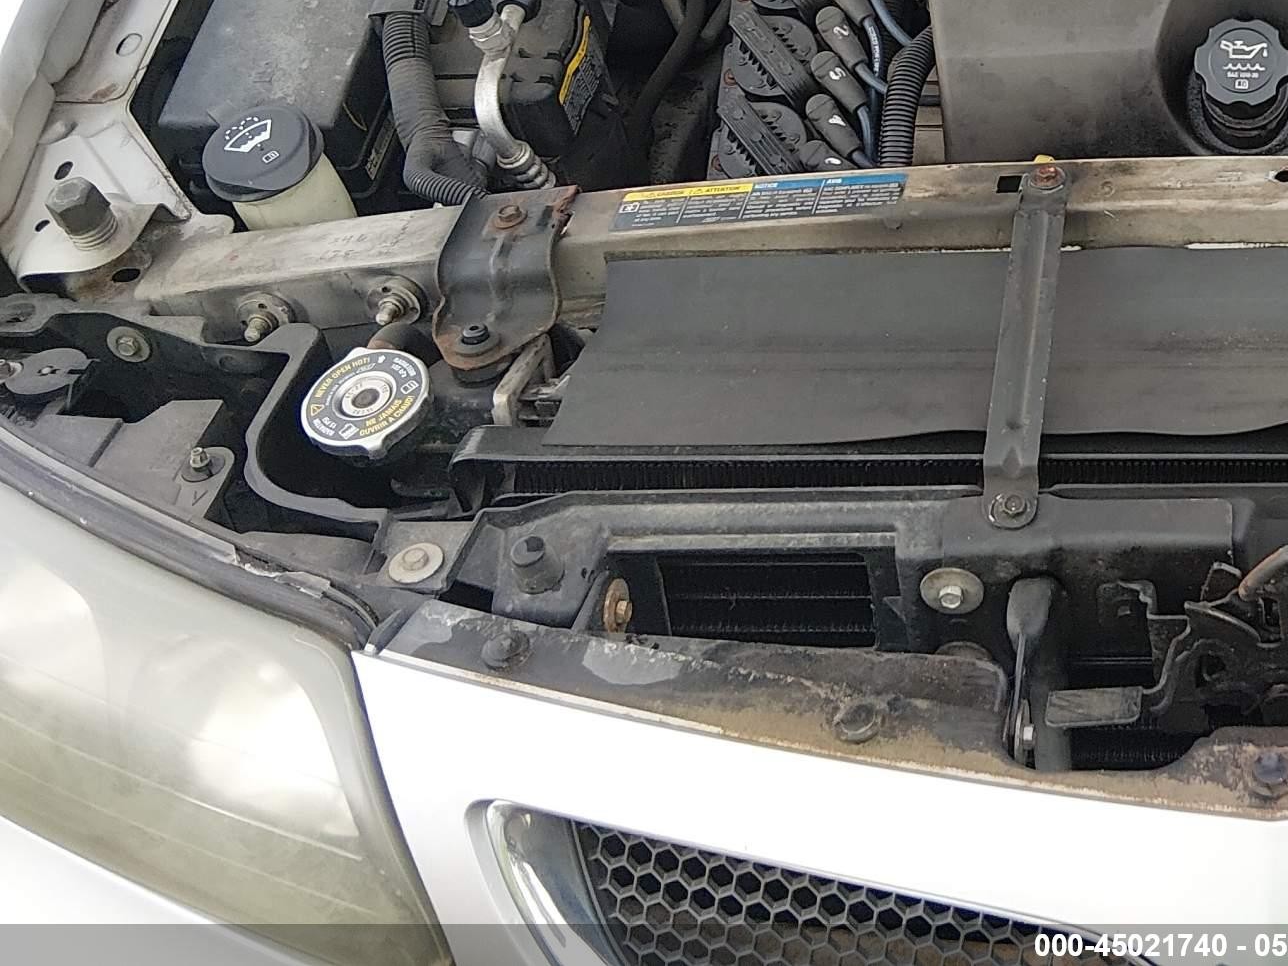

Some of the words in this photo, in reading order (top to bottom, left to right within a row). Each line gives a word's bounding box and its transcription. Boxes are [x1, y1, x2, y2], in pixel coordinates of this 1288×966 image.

[314, 376, 334, 398] NEVER
[331, 363, 352, 379] OPEN
[352, 356, 371, 369] HOT!
[359, 422, 388, 436] OUVRIR
[396, 395, 415, 418] CHAUD!
[377, 398, 402, 420] JAMAIS
